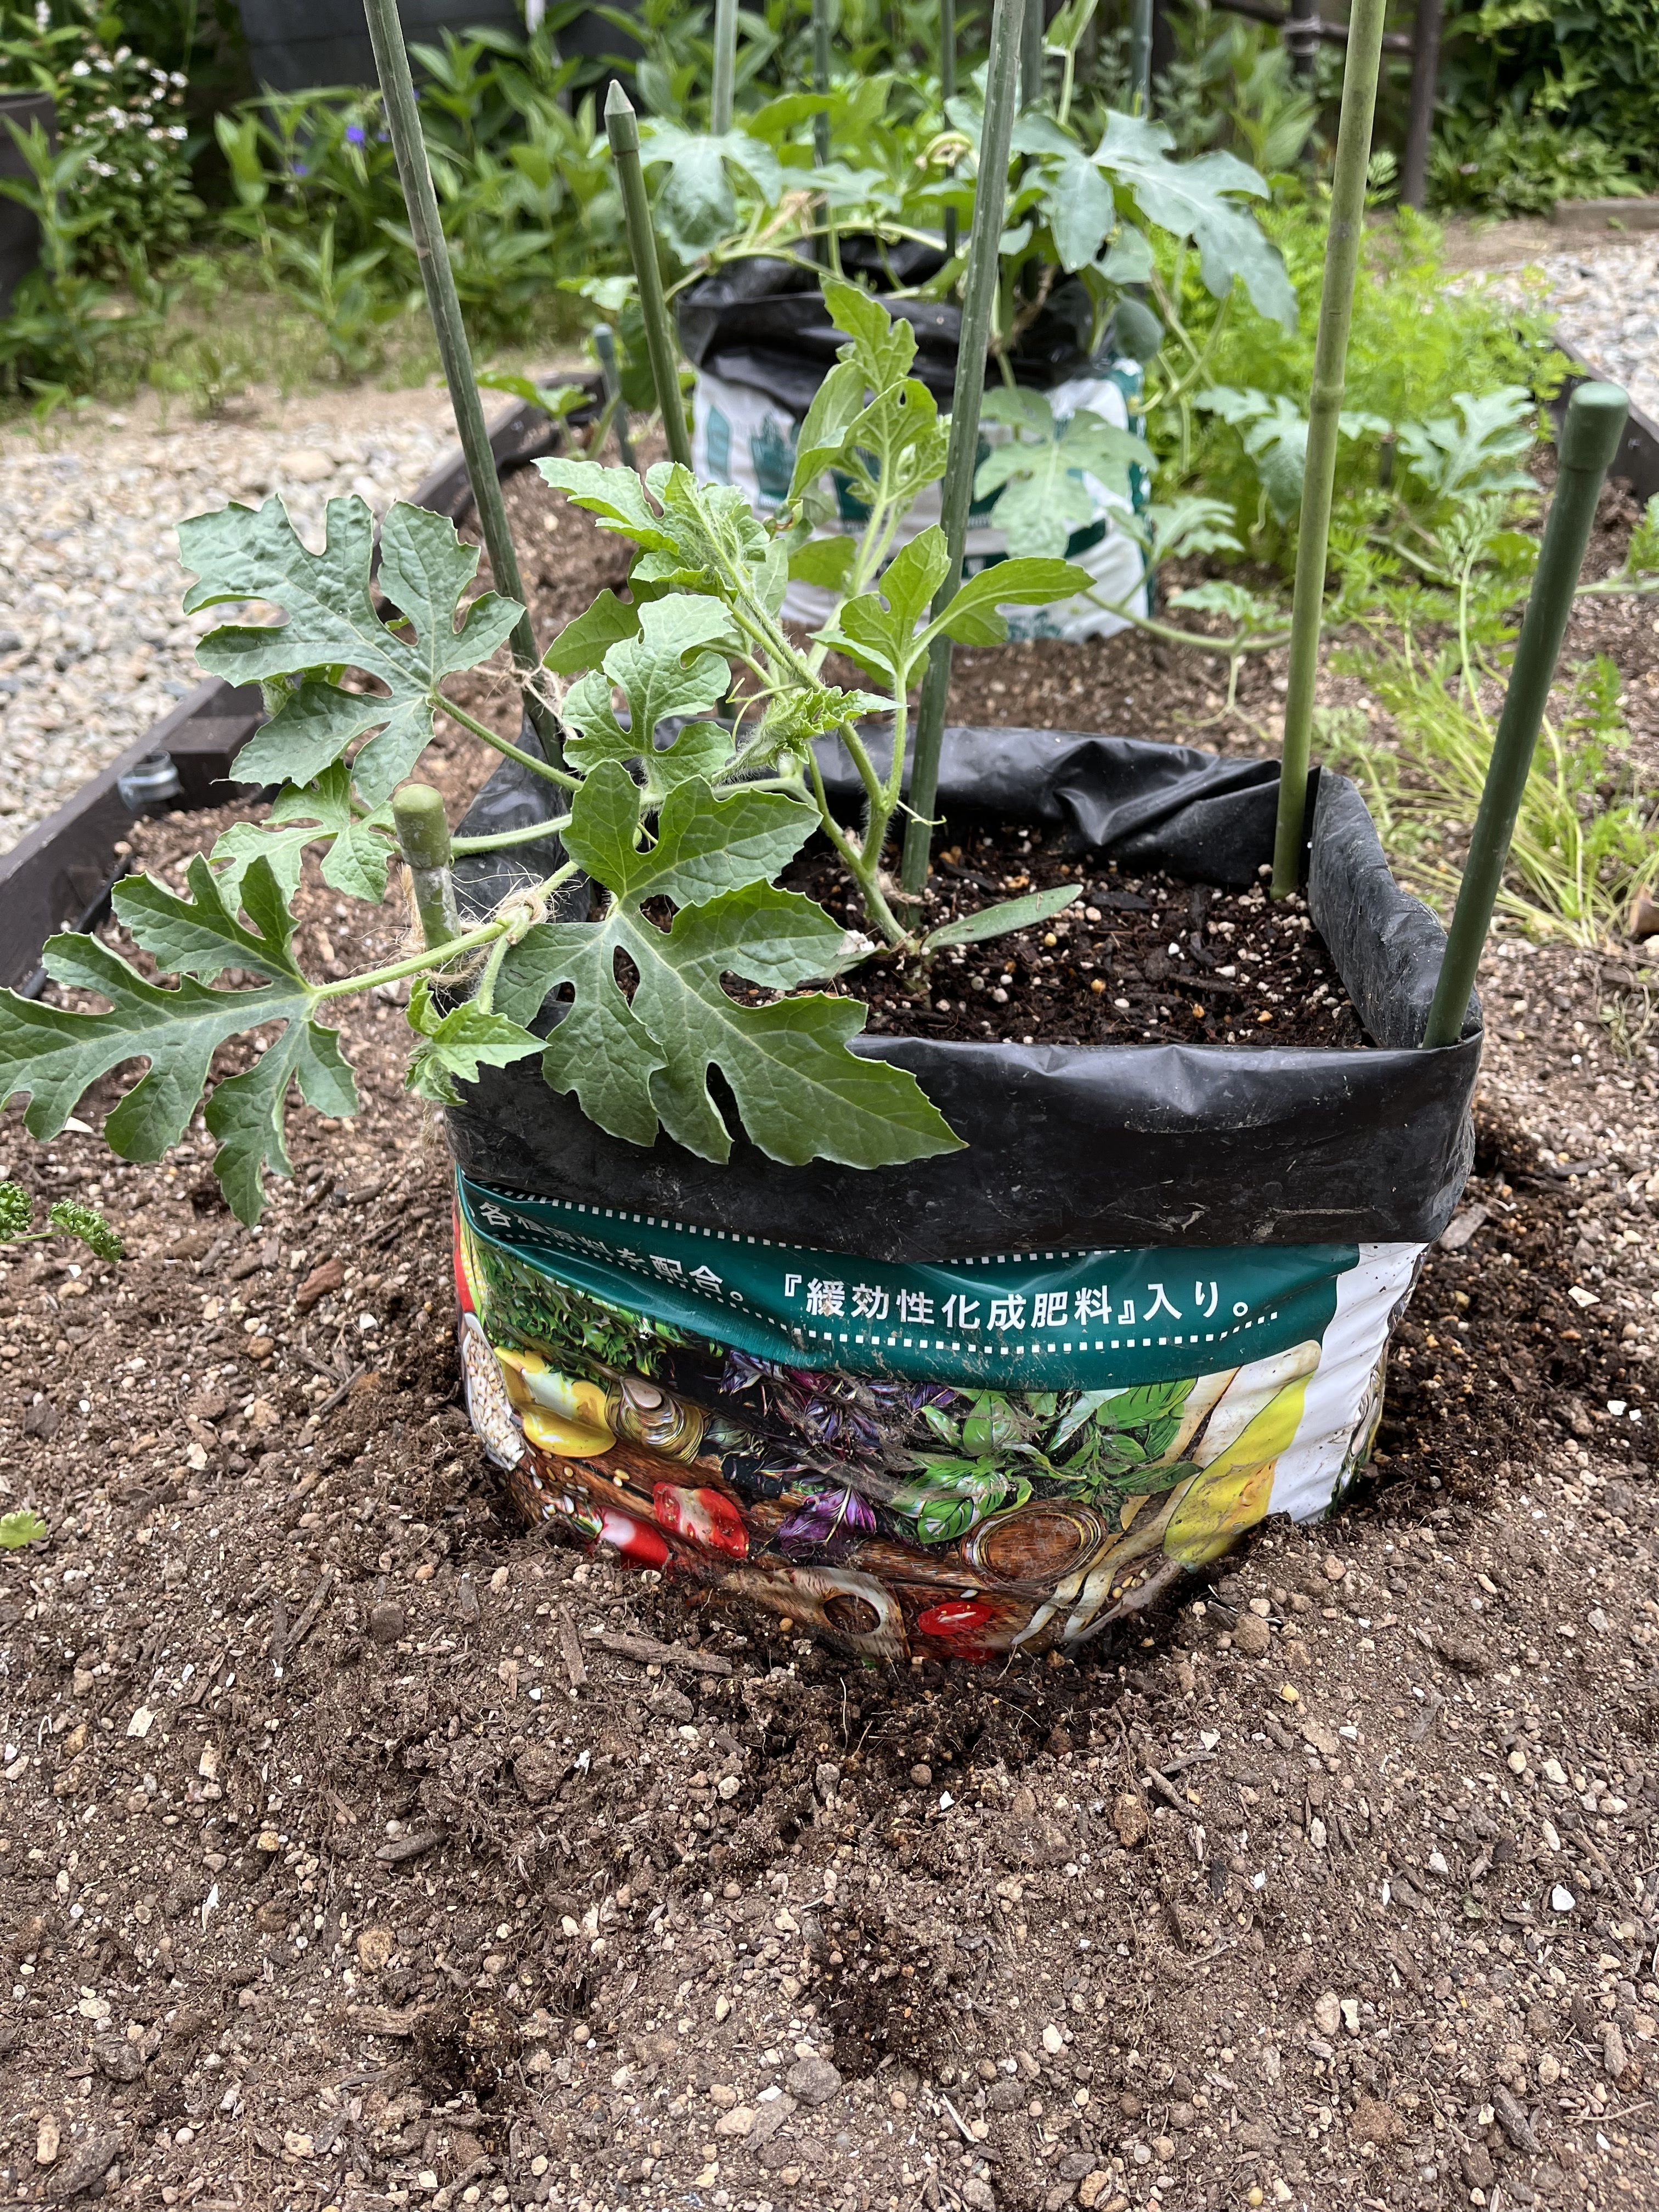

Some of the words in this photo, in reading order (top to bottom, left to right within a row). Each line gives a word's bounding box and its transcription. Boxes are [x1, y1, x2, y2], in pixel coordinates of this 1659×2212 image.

[783, 1273, 1249, 1331] 『緩効性化成肥料』入り。
